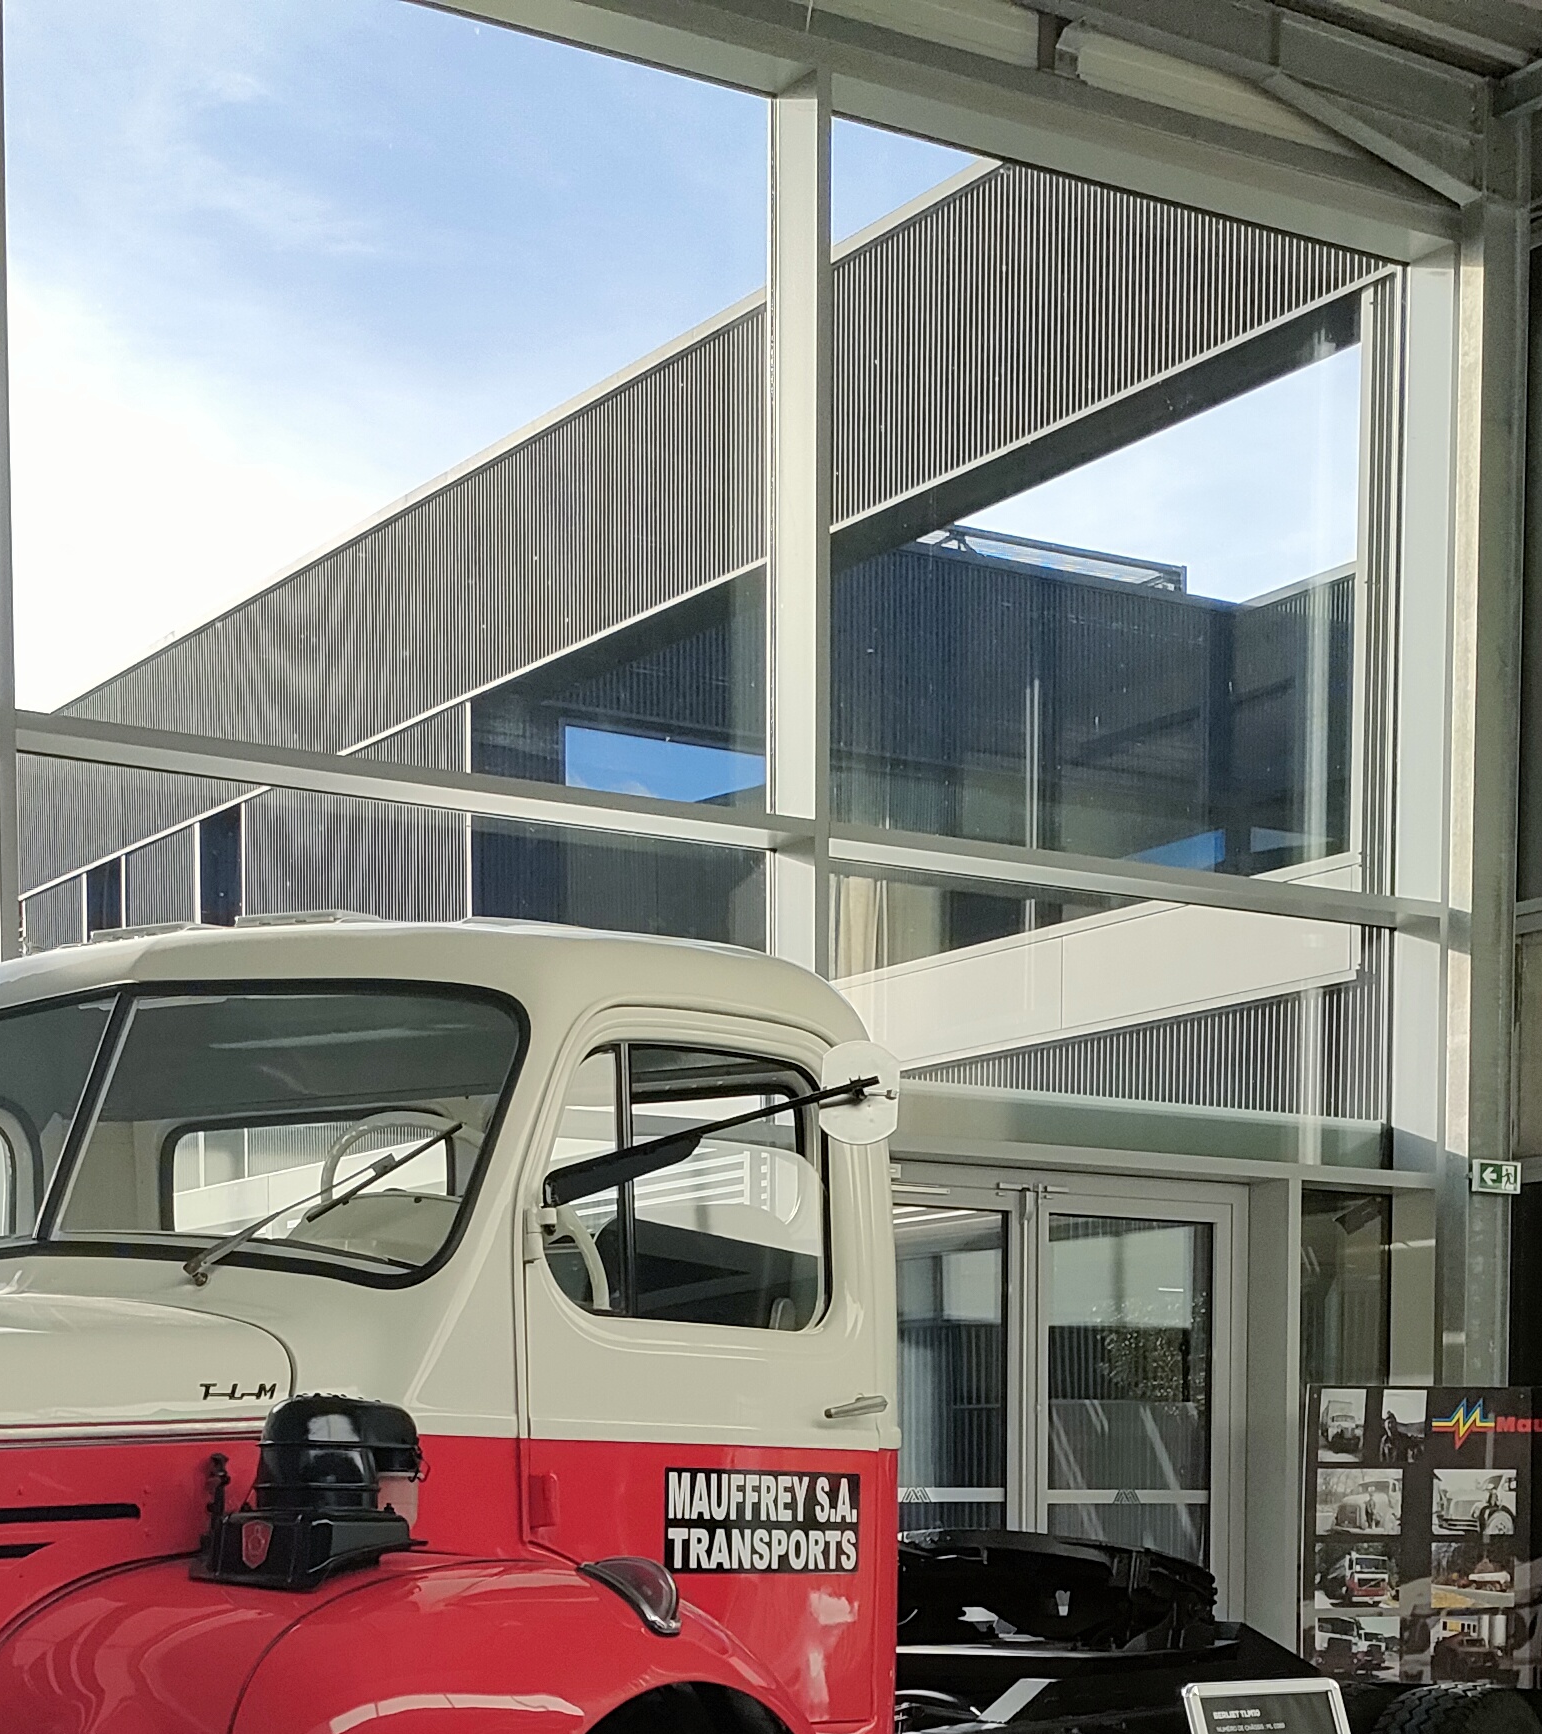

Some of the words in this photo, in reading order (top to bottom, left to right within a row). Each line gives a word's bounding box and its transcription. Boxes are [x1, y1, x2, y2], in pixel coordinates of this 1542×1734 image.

[668, 1471, 809, 1522] MAUFFREY
[814, 1476, 858, 1523] S.A.
[667, 1527, 857, 1570] TRANSPORTS
